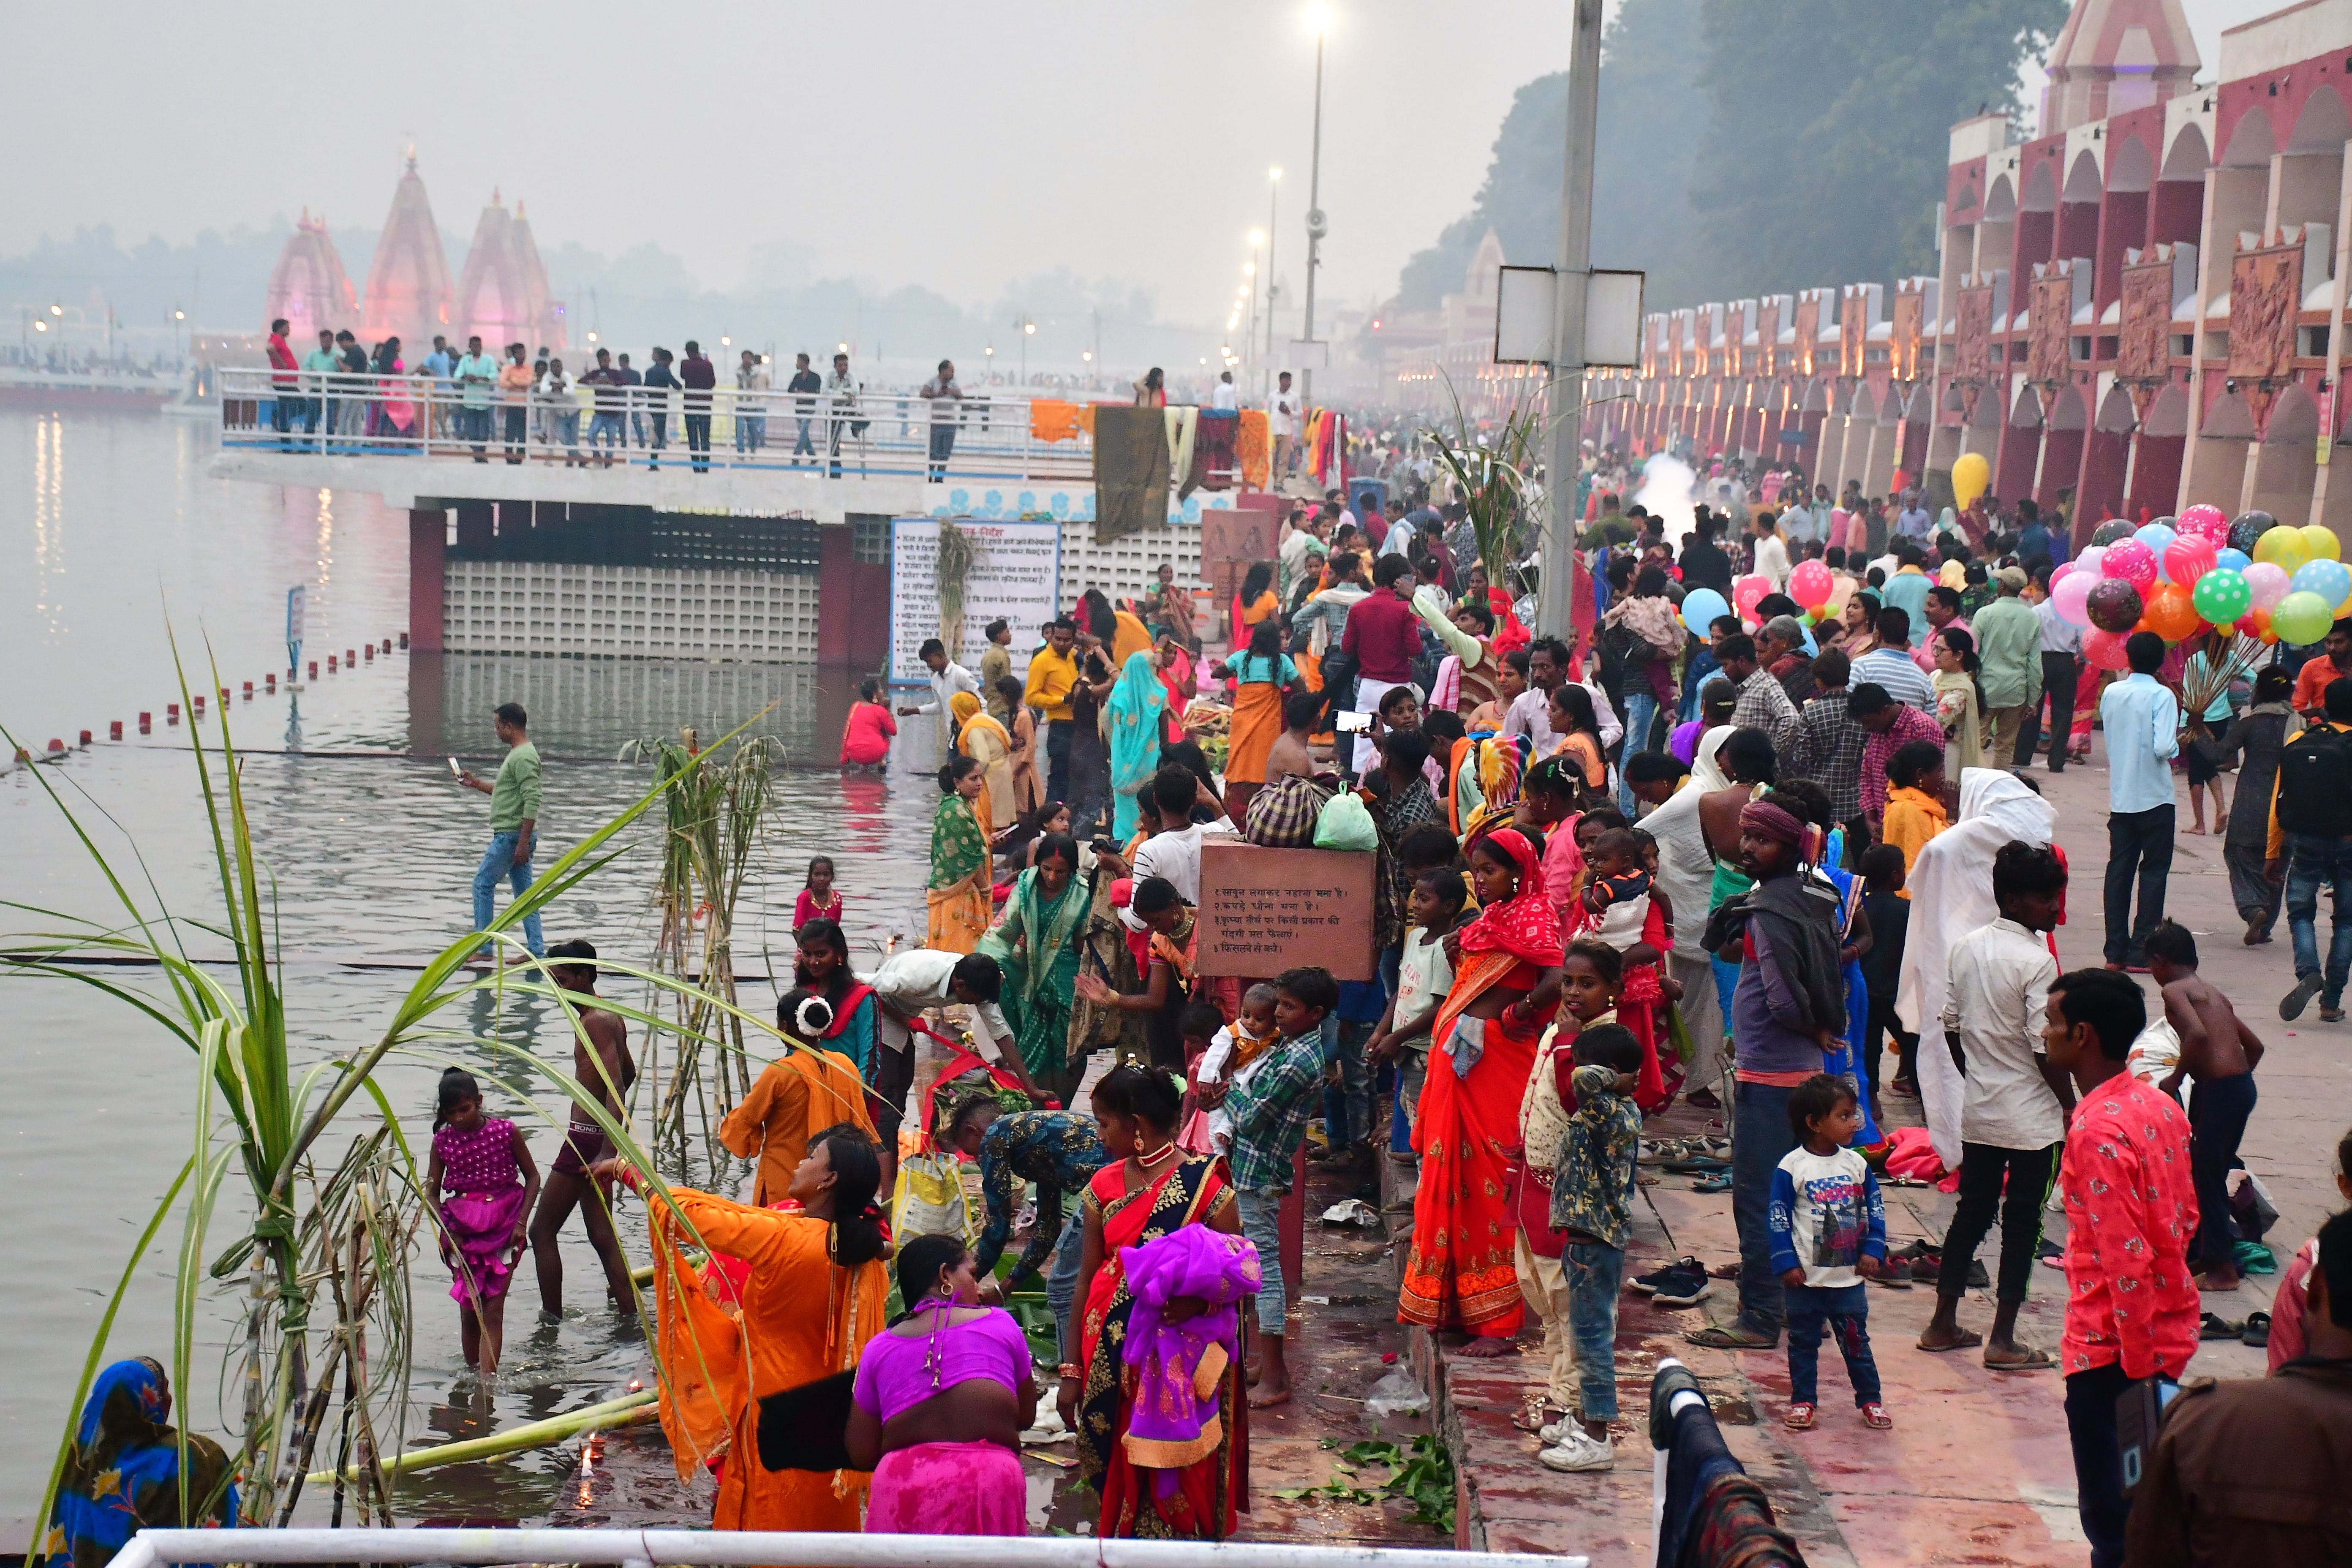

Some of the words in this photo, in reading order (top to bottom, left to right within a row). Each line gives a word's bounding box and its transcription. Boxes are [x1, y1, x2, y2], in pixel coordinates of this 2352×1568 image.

[1222, 889, 1245, 898] साबुन
[1251, 899, 1275, 911] धोना
[1277, 915, 1299, 925] किसी
[1328, 915, 1339, 925] की
[1221, 928, 1245, 939] गंदगी
[1220, 942, 1252, 953] फिसलने
[574, 1124, 597, 1132] BOND
